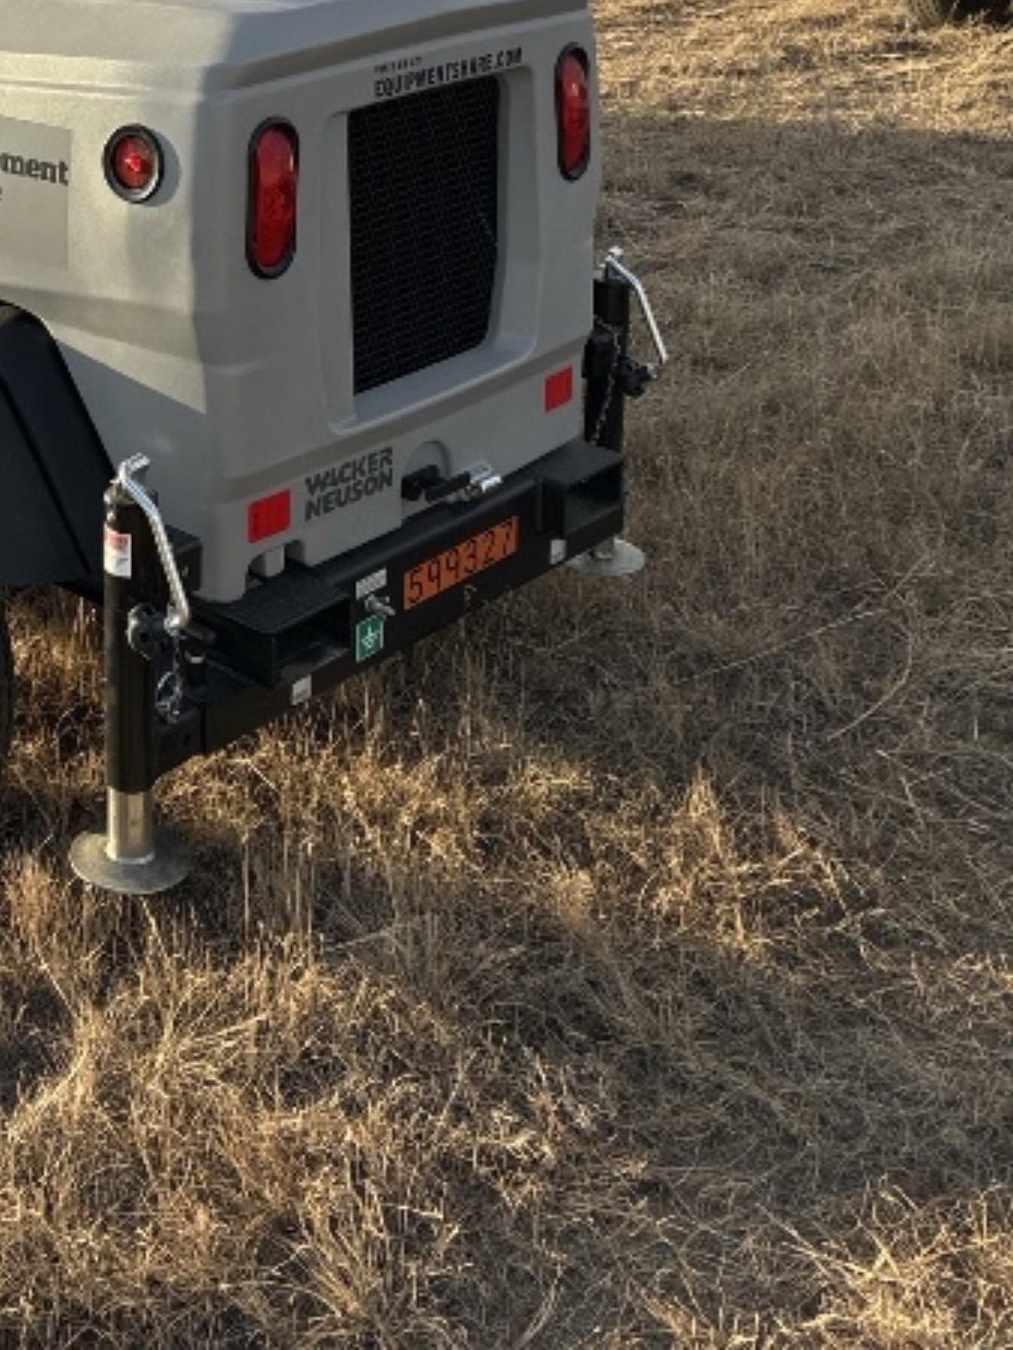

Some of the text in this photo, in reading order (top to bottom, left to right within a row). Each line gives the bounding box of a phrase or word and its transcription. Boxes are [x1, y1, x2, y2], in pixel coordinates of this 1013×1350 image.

[305, 446, 393, 497] WACKER
[305, 466, 393, 523] NEUSON
[409, 520, 514, 605] 599327
